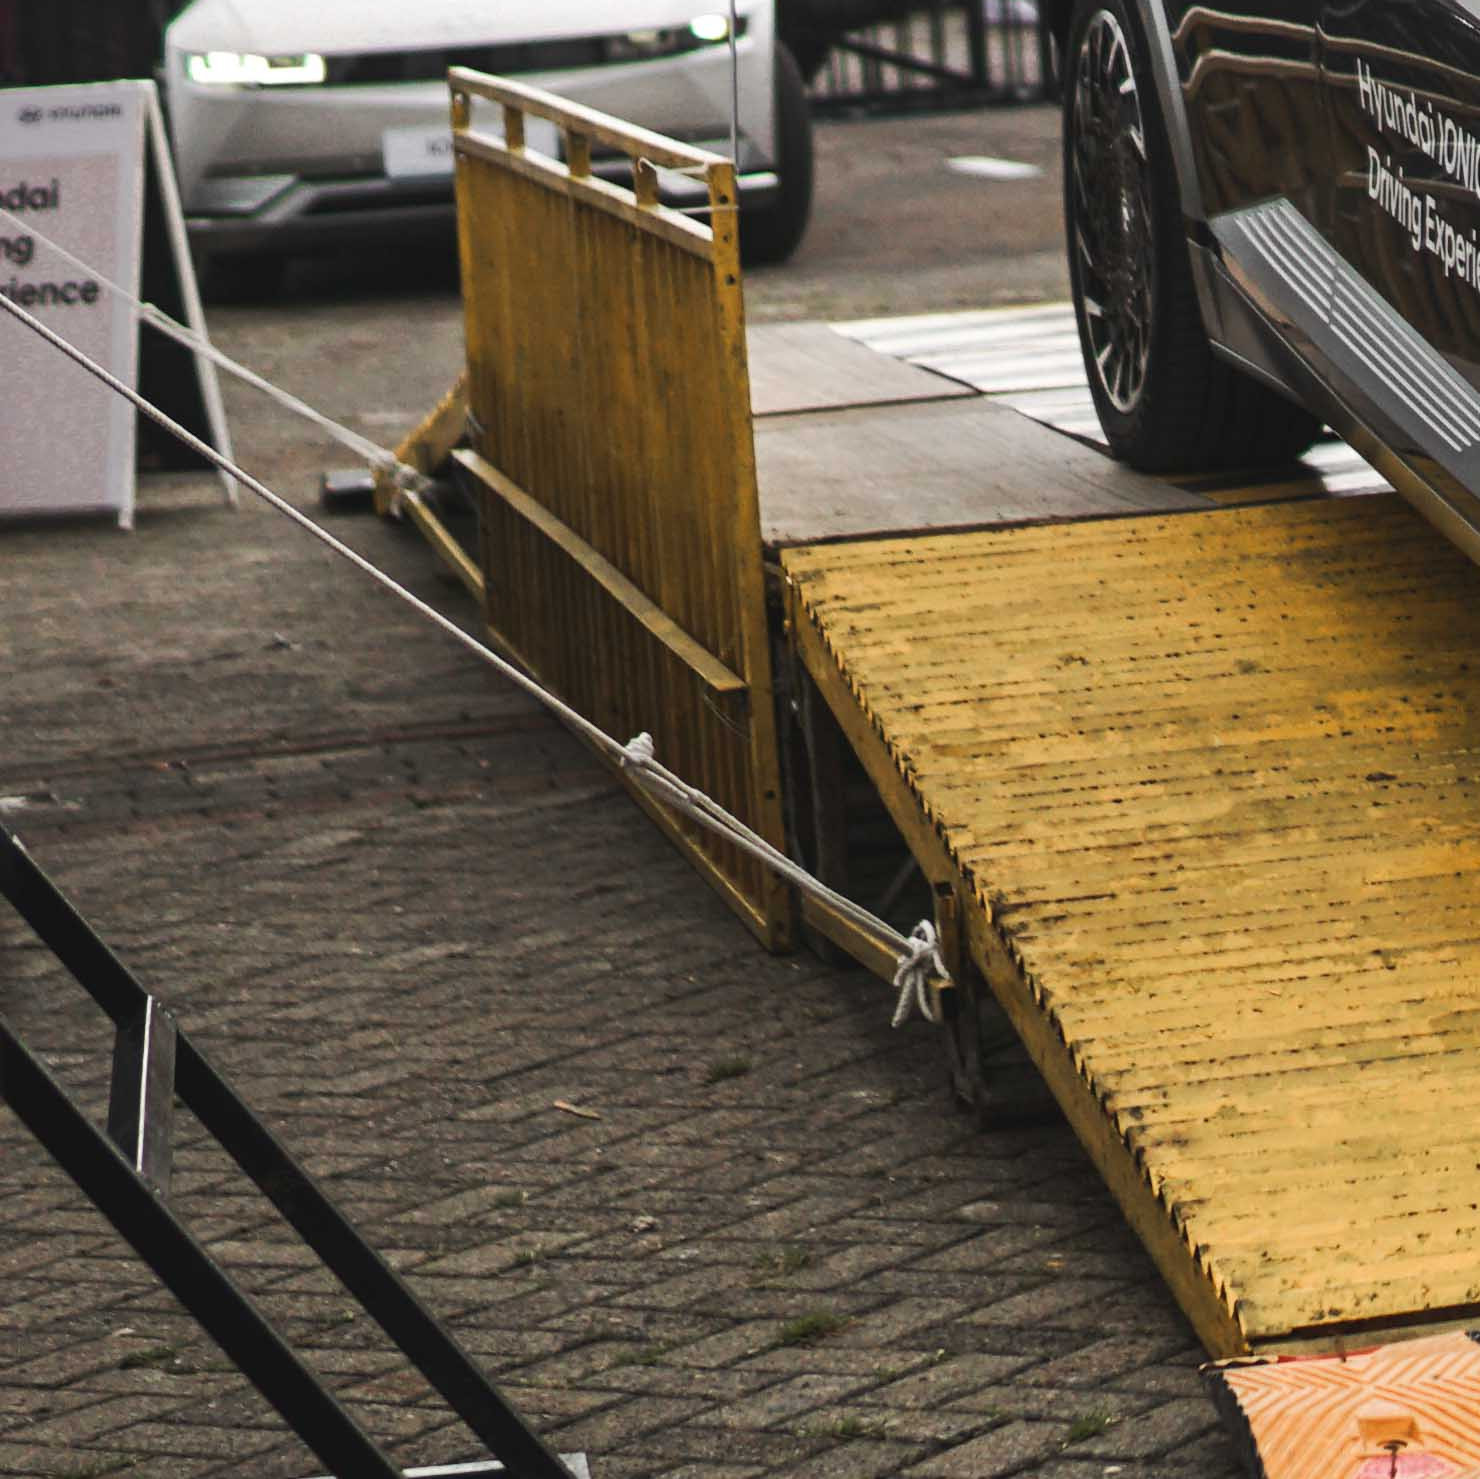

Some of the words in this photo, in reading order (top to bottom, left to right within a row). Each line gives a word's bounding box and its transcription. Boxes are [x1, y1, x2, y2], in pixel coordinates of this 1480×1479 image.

[1356, 57, 1436, 161] Hyundai
[0, 176, 61, 210] dai
[1367, 144, 1423, 252] Driving
